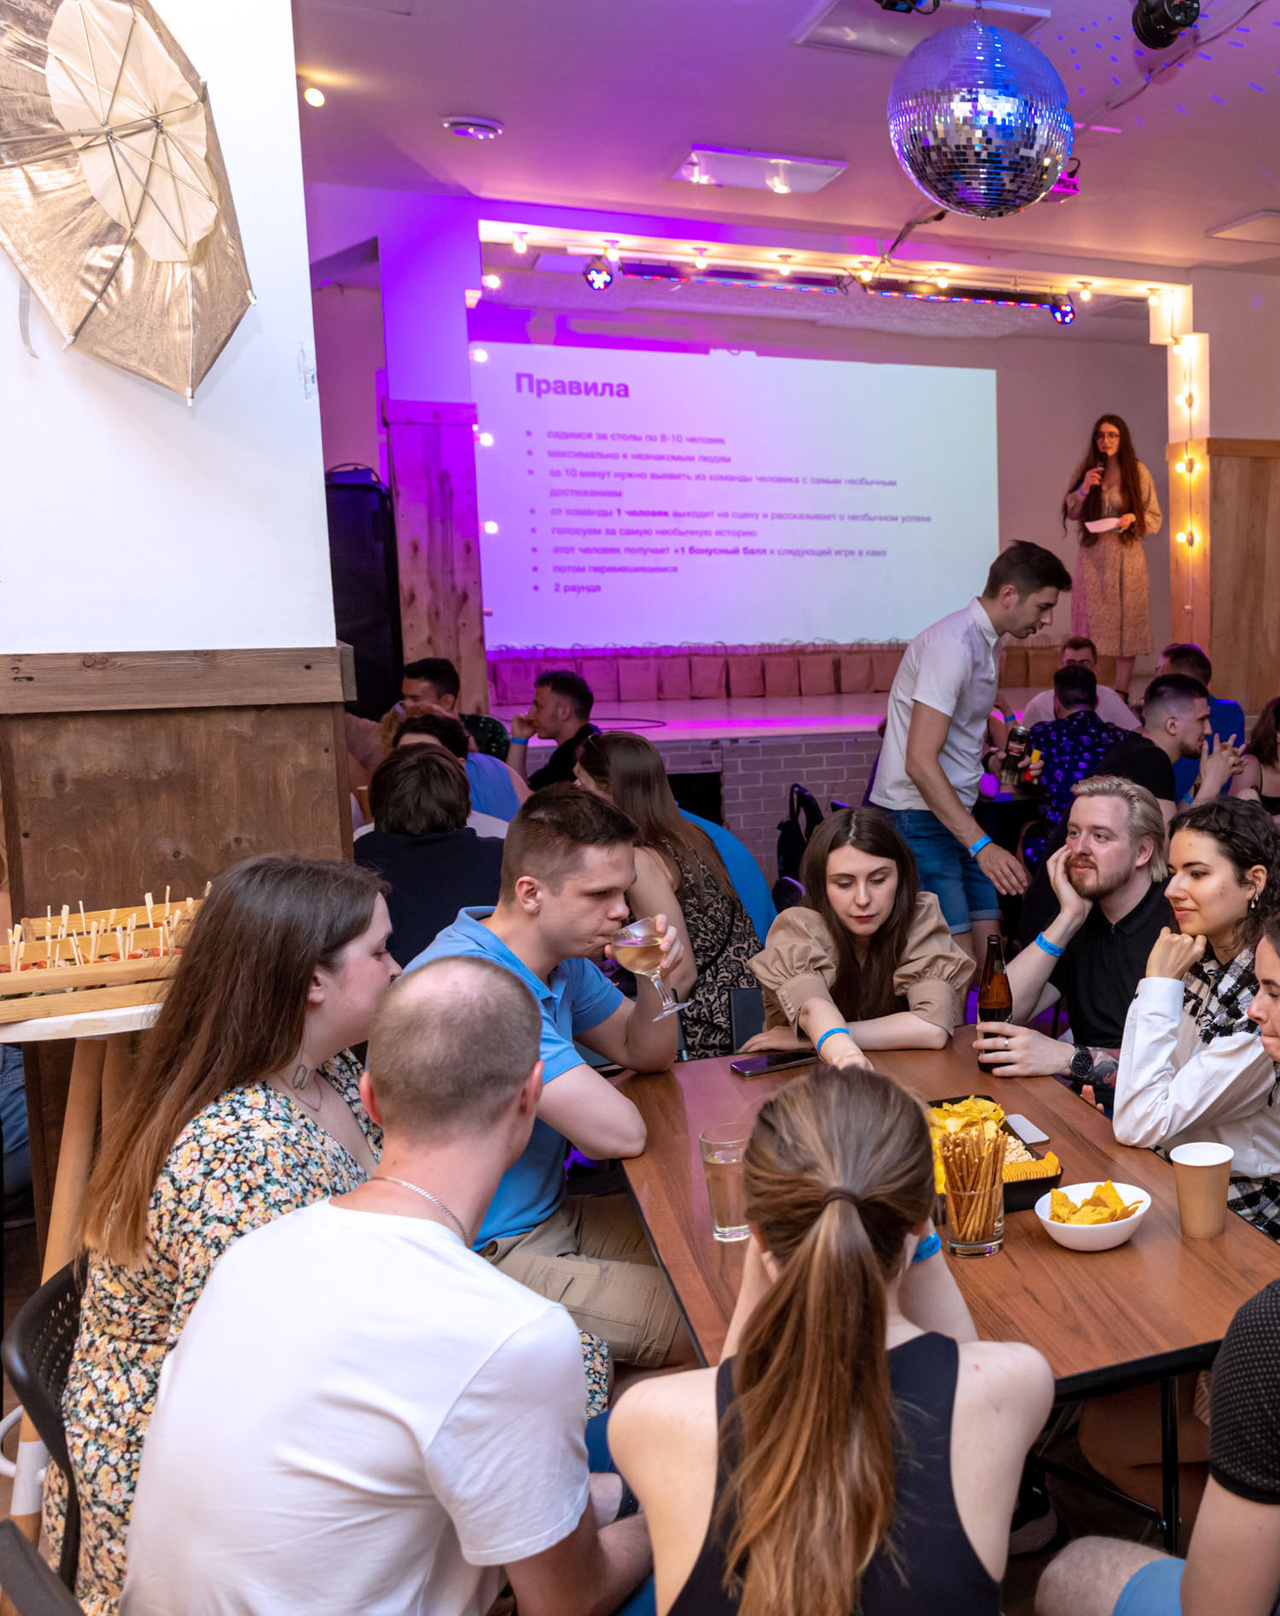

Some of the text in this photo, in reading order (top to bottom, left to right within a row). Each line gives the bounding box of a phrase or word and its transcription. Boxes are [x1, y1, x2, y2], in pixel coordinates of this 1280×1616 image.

[515, 372, 630, 398] Правила
[645, 434, 657, 443] по
[565, 468, 577, 477] 10
[742, 546, 767, 556] балл
[563, 585, 602, 594] раунда
